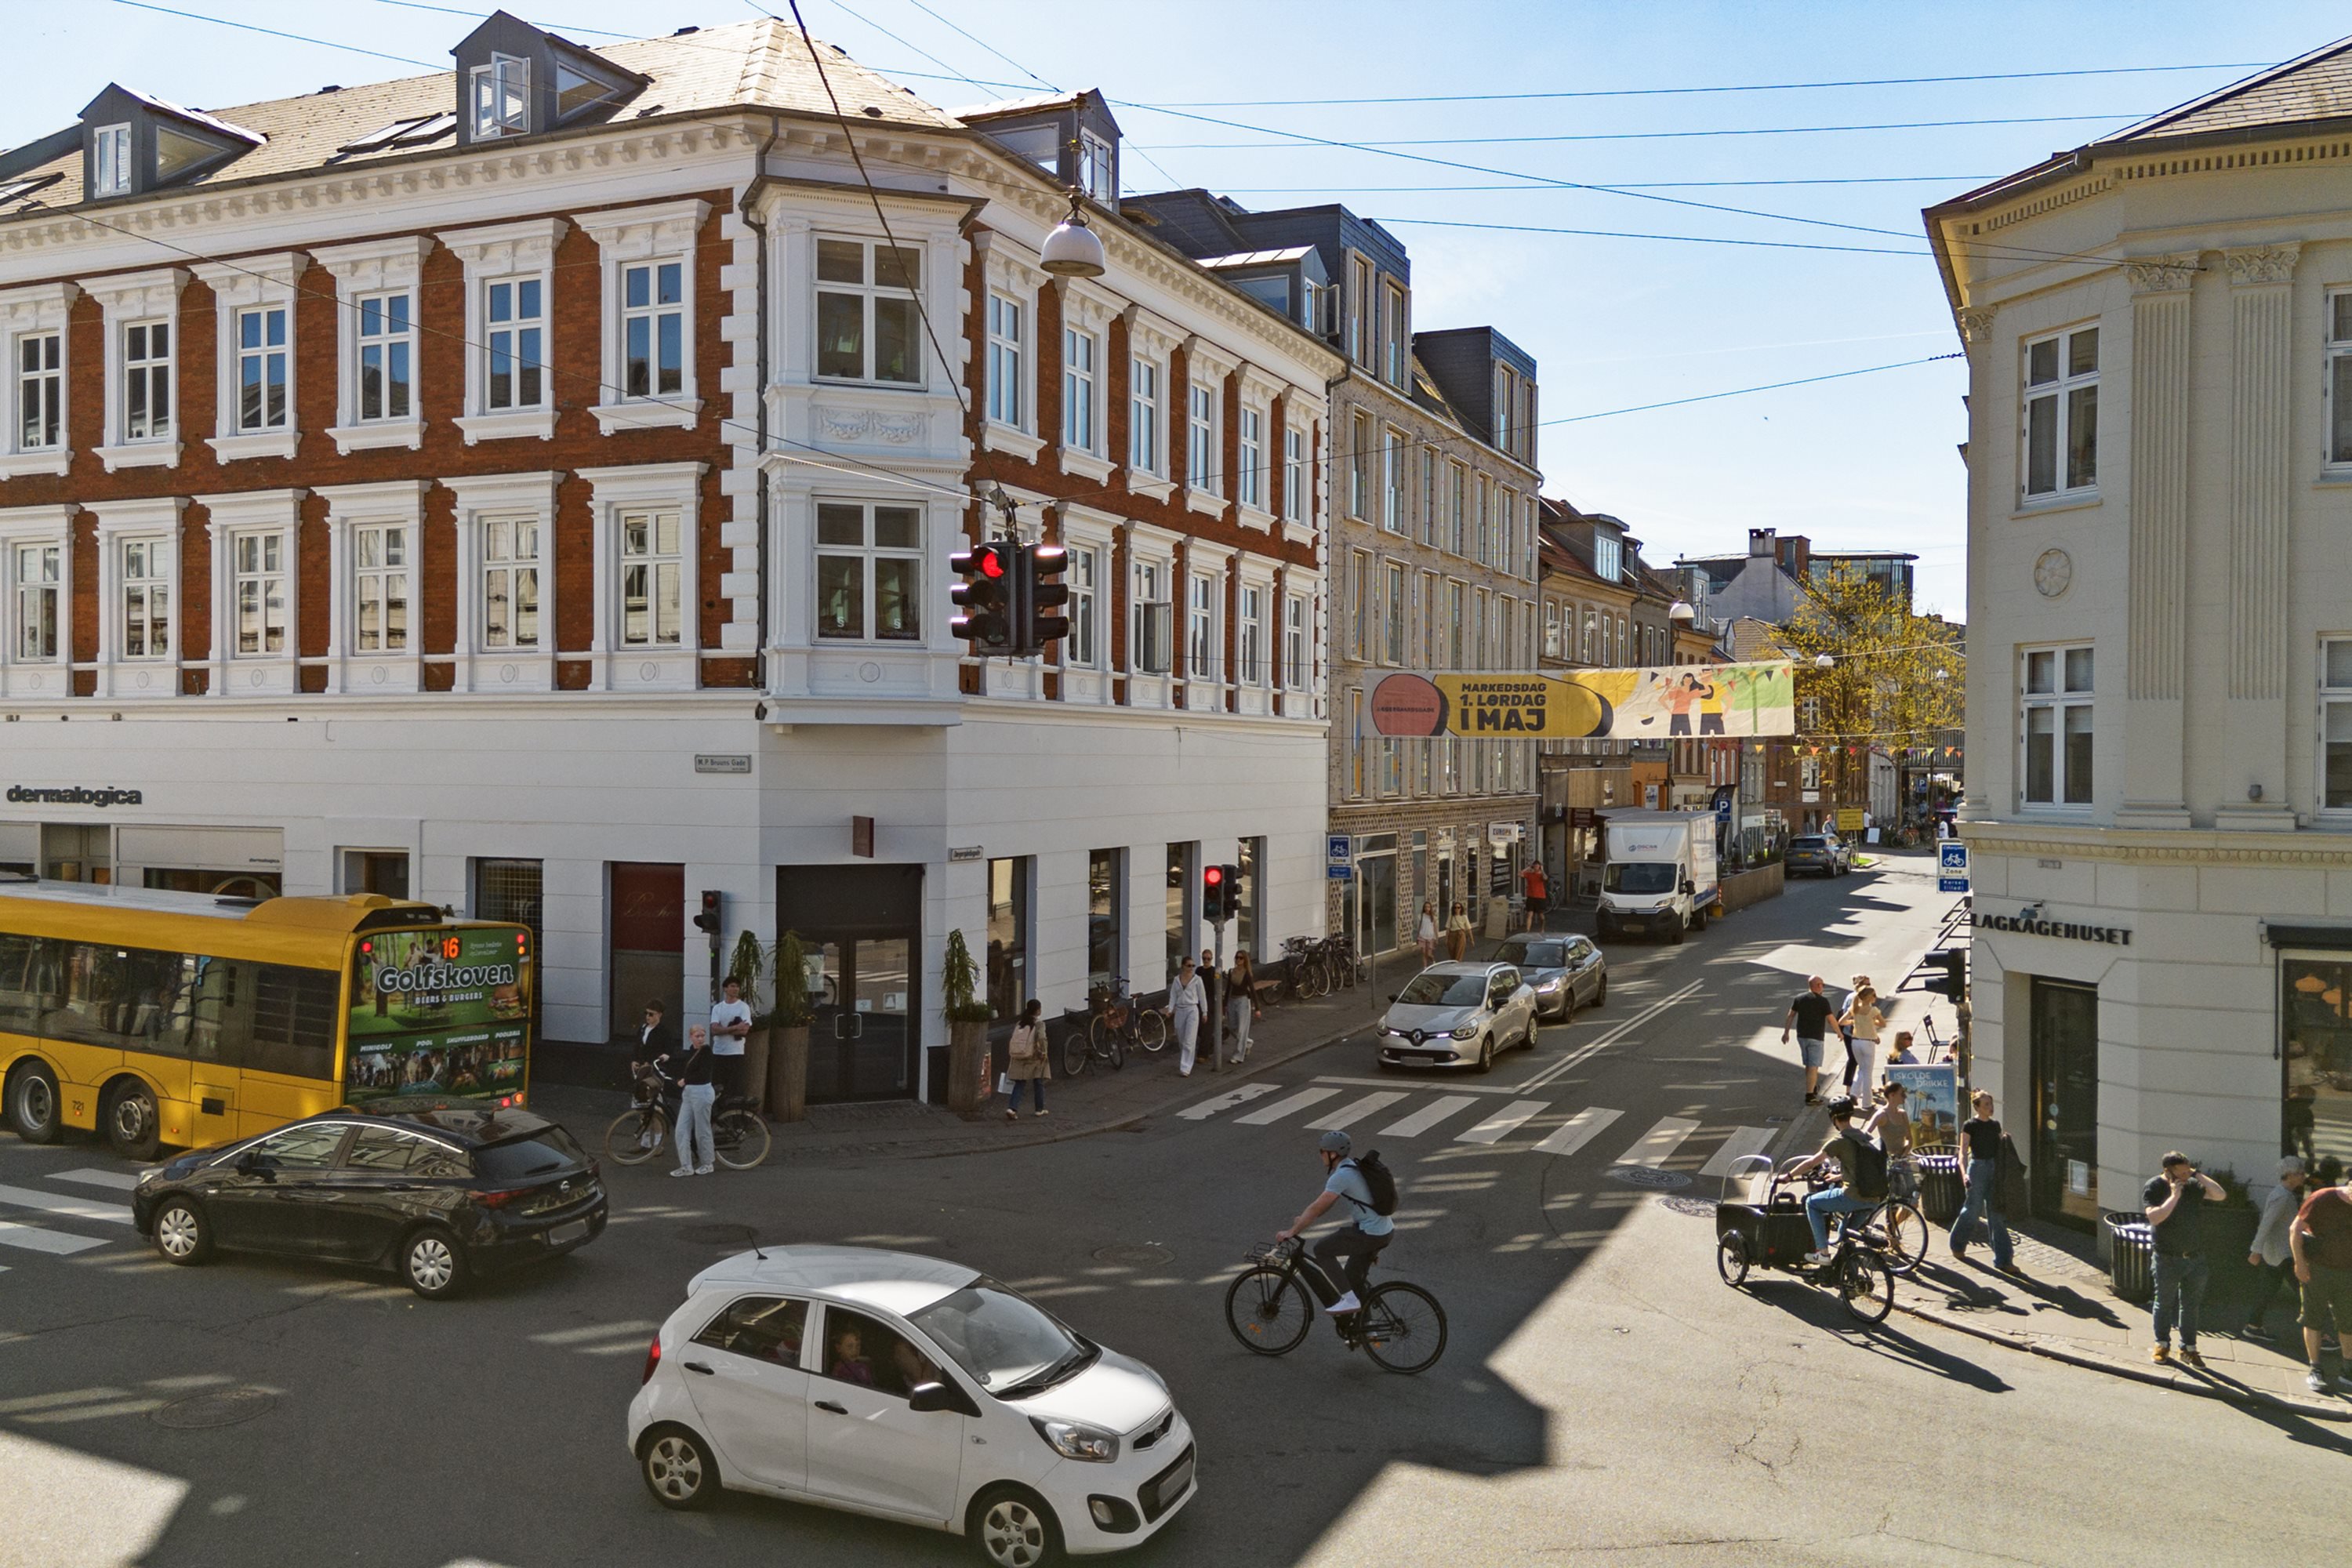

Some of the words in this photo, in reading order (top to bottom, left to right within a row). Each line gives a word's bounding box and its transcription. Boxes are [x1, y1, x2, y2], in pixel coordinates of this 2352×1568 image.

[1461, 683, 1547, 692] MARKEDSDAG
[1460, 695, 1473, 706] 1.
[1477, 694, 1546, 706] LØRDAG
[1461, 709, 1469, 730] I
[1478, 709, 1546, 731] MAJ
[6, 785, 143, 808] dermalogica
[1719, 800, 1729, 812] P
[1970, 913, 2132, 946] LAGKAGEHUSET
[441, 937, 459, 959] 16
[378, 963, 514, 993] Golfskoven
[415, 994, 440, 1004] BEERS
[449, 992, 483, 1001] BURGERS
[360, 1043, 393, 1052] MINIGOLF
[1894, 1072, 1931, 1080] ISKOLDE
